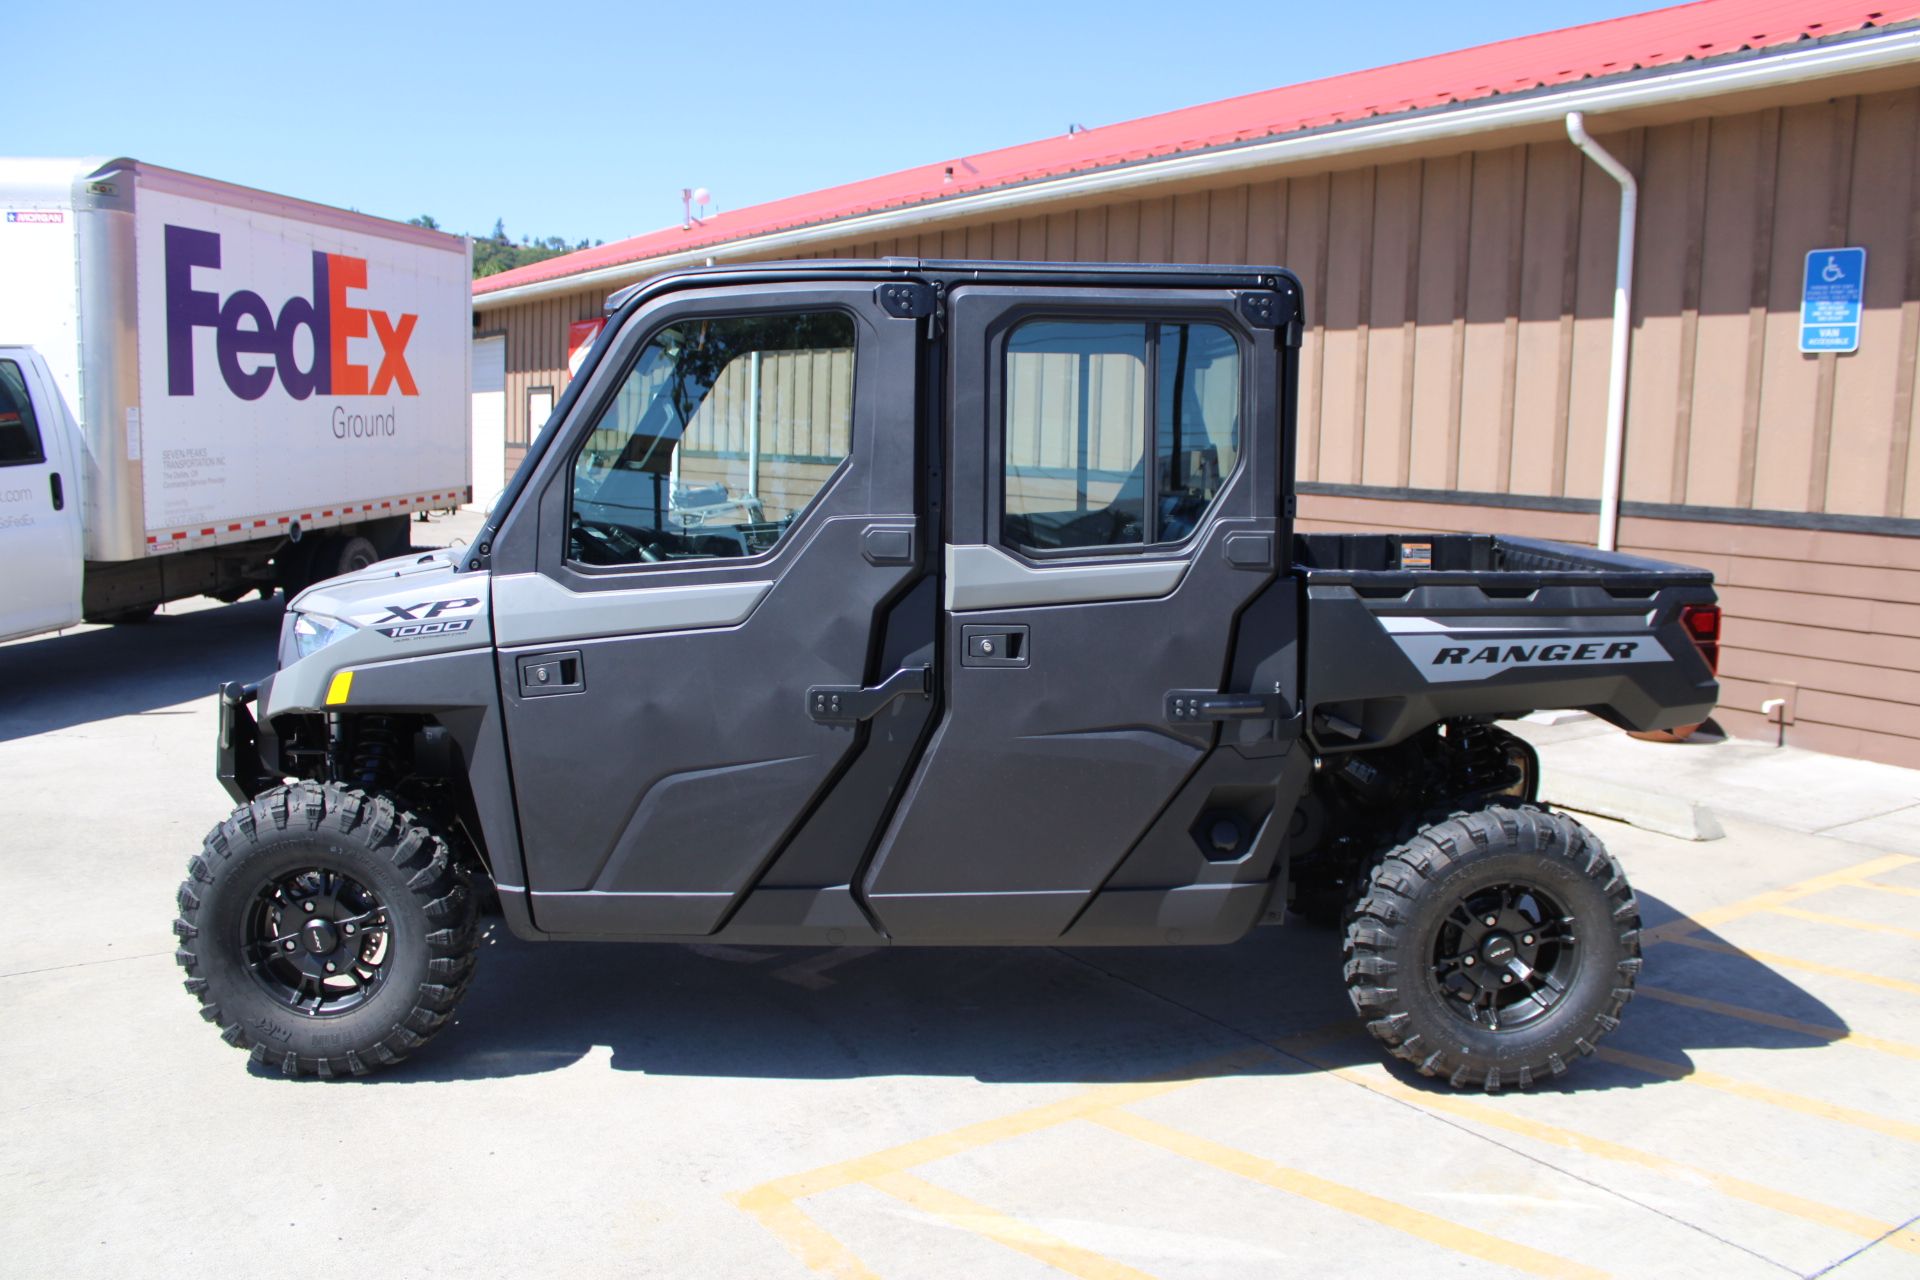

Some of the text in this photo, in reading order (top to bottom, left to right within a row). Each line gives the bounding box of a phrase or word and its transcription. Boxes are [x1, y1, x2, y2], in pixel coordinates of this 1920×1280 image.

[164, 224, 419, 401] FedEx
[1818, 328, 1840, 338] VAN
[332, 405, 395, 439] Ground
[371, 598, 480, 624] XP
[390, 620, 467, 637] 1000
[1432, 642, 1639, 664] RANGER
